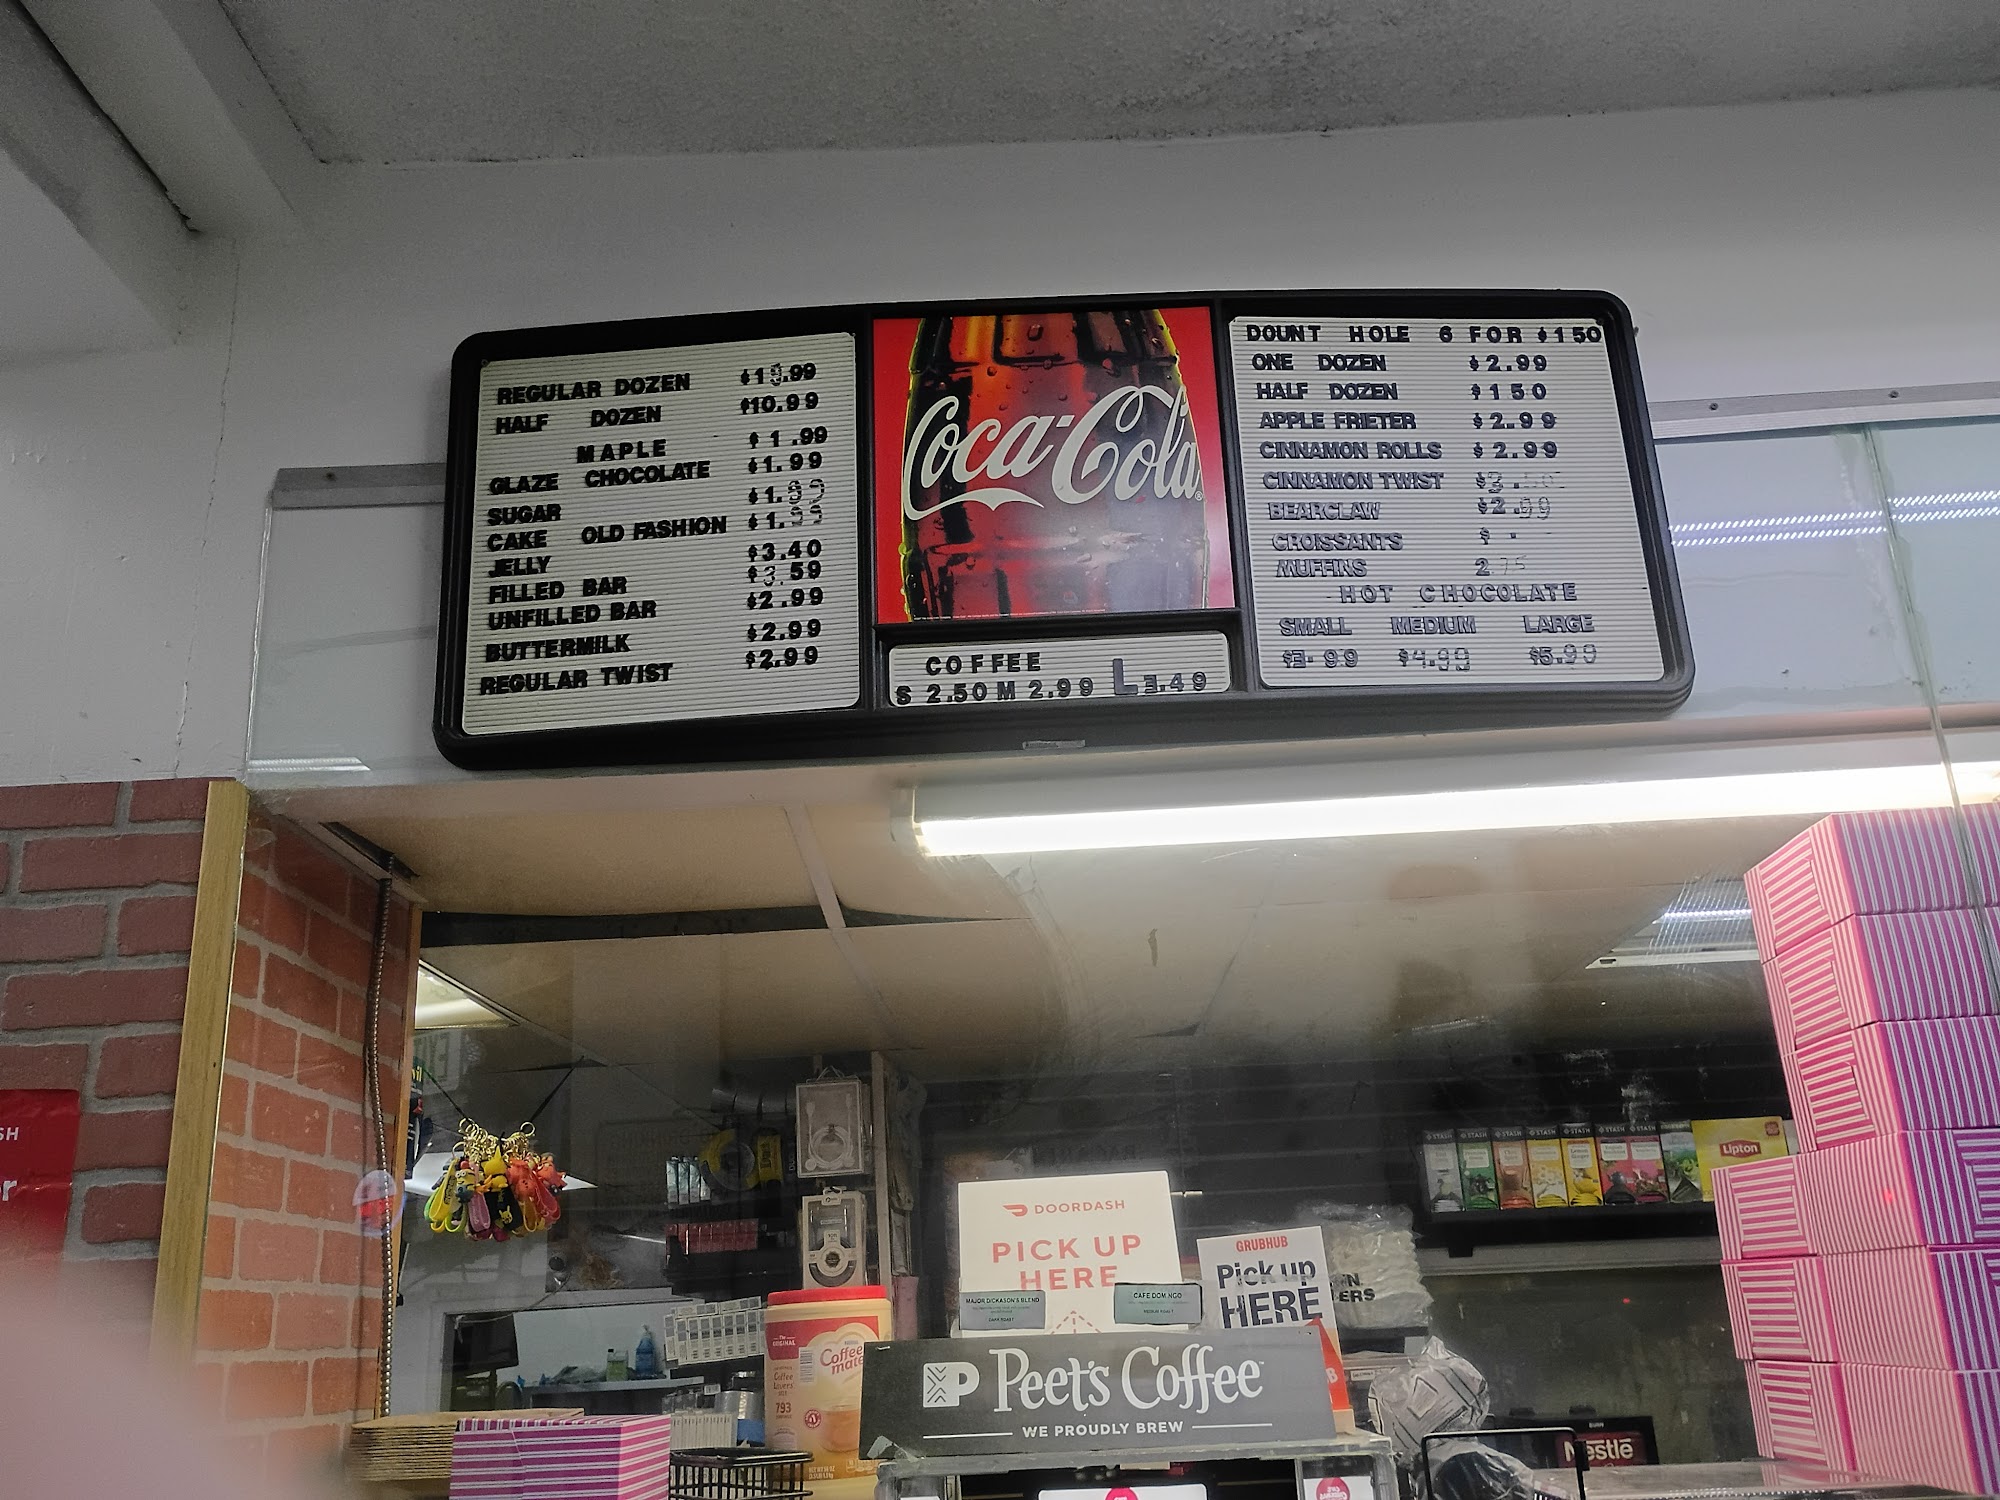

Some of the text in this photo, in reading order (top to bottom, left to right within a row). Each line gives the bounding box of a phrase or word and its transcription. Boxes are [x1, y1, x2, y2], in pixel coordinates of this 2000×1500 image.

[1246, 324, 1321, 342] DOUNT
[1349, 325, 1410, 343] HOLE
[1439, 325, 1453, 343] 6
[1469, 325, 1522, 343] FOR
[1252, 353, 1547, 371] ONE DOZEN $2.99
[497, 380, 602, 405] REGULAR
[614, 373, 691, 396] DOZEN
[1256, 382, 1308, 399] HALF
[1329, 382, 1398, 400] DOZEN
[496, 391, 819, 435] HALF DOZEN $10.99
[1259, 411, 1556, 429] APPLE FRIETER $2.99
[576, 426, 828, 463] MAPLE $1.99
[903, 385, 1200, 521] Coca-Cola
[1259, 441, 1558, 459] CINNAMON ROLLS $2.99
[489, 451, 822, 495] GLAZE CHOCOLATE $1.99
[1263, 471, 1374, 490] CINNAMON
[1379, 471, 1444, 490] TWIST
[487, 504, 562, 526] SUGAR
[1268, 501, 1381, 520] BEARCLAW
[487, 530, 548, 551] CAKE
[581, 524, 625, 545] OLD
[633, 516, 727, 541] FASHION
[1272, 532, 1404, 551] CROISSANTS
[488, 538, 822, 578] JELLY $3.40
[1276, 558, 1368, 577] MUFFINS
[489, 580, 565, 604] FILLED
[582, 576, 628, 597] BAR
[1339, 583, 1578, 603] HOT CHOCOLATE
[488, 586, 824, 630] UNFILLED BAR $2.99
[1279, 614, 1595, 636] SMALL MEDIUM LARGE
[486, 618, 822, 662] BUTTERMILK $2.99
[925, 652, 1041, 675] COFFEE
[1529, 643, 1597, 665] $5.99
[480, 645, 819, 695] REGULAR TWIST $2.99
[895, 685, 912, 706] S
[926, 682, 988, 704] 2.50
[997, 680, 1016, 700] M
[1028, 677, 1094, 699] 2.99
[1113, 658, 1138, 696] L
[1722, 1143, 1758, 1155] Lipton
[1034, 1200, 1125, 1214] DOORDASH
[992, 1234, 1141, 1263] PICK UP
[1236, 1235, 1289, 1252] GRUBHUB
[1020, 1265, 1118, 1291] HERE
[1217, 1260, 1317, 1289] Pick up
[1220, 1287, 1323, 1329] HERE
[772, 1339, 796, 1347] ORIGINAL
[820, 1345, 863, 1367] Coffee
[831, 1355, 864, 1375] mate
[773, 1371, 794, 1381] Coffee
[989, 1347, 1111, 1412] Peet's
[1122, 1343, 1263, 1414] Coffee
[775, 1402, 792, 1413] 793
[1022, 1421, 1184, 1438] WE PROUDLY BREW
